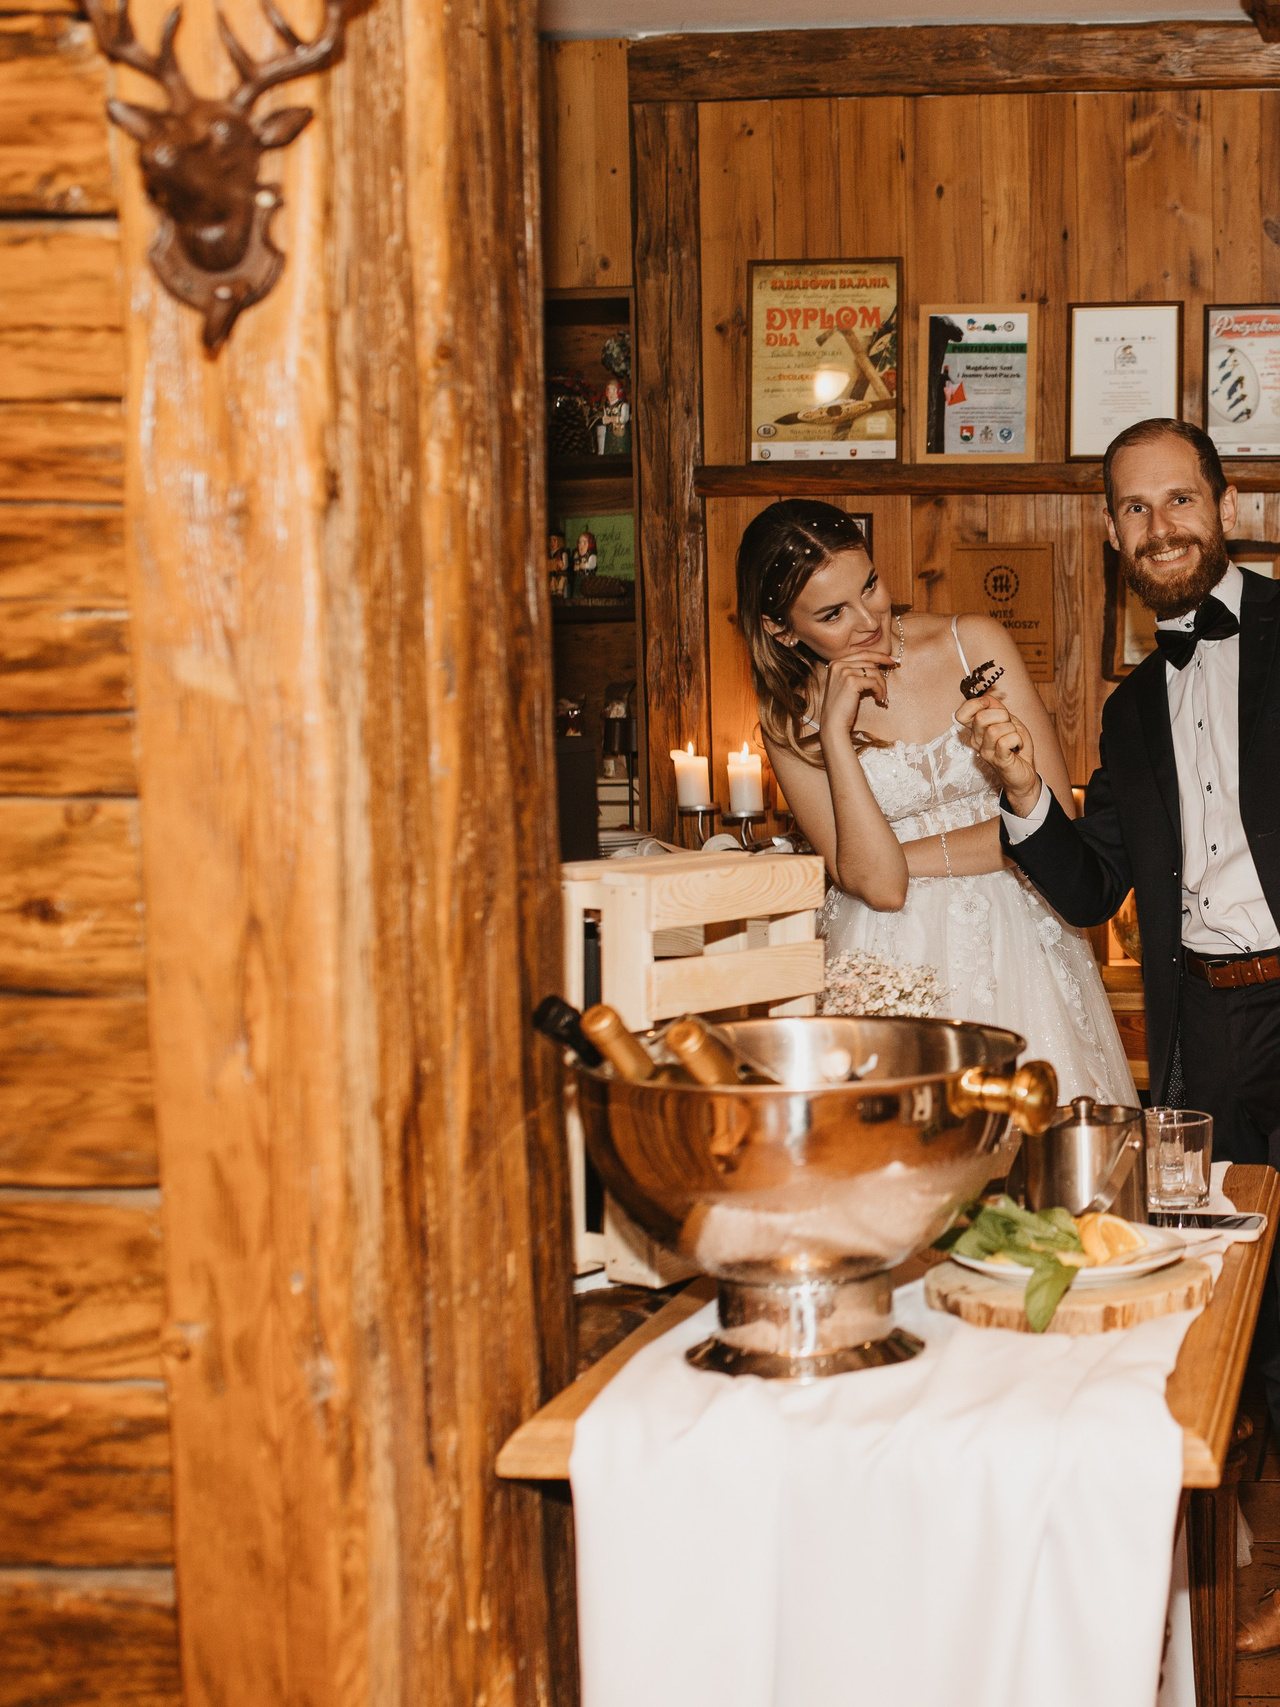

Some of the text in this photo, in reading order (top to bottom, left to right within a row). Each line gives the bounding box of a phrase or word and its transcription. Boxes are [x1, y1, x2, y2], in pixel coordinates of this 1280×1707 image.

[765, 306, 882, 331] DYPLOM
[765, 332, 800, 348] DLA
[990, 609, 1014, 618] WIEŚ
